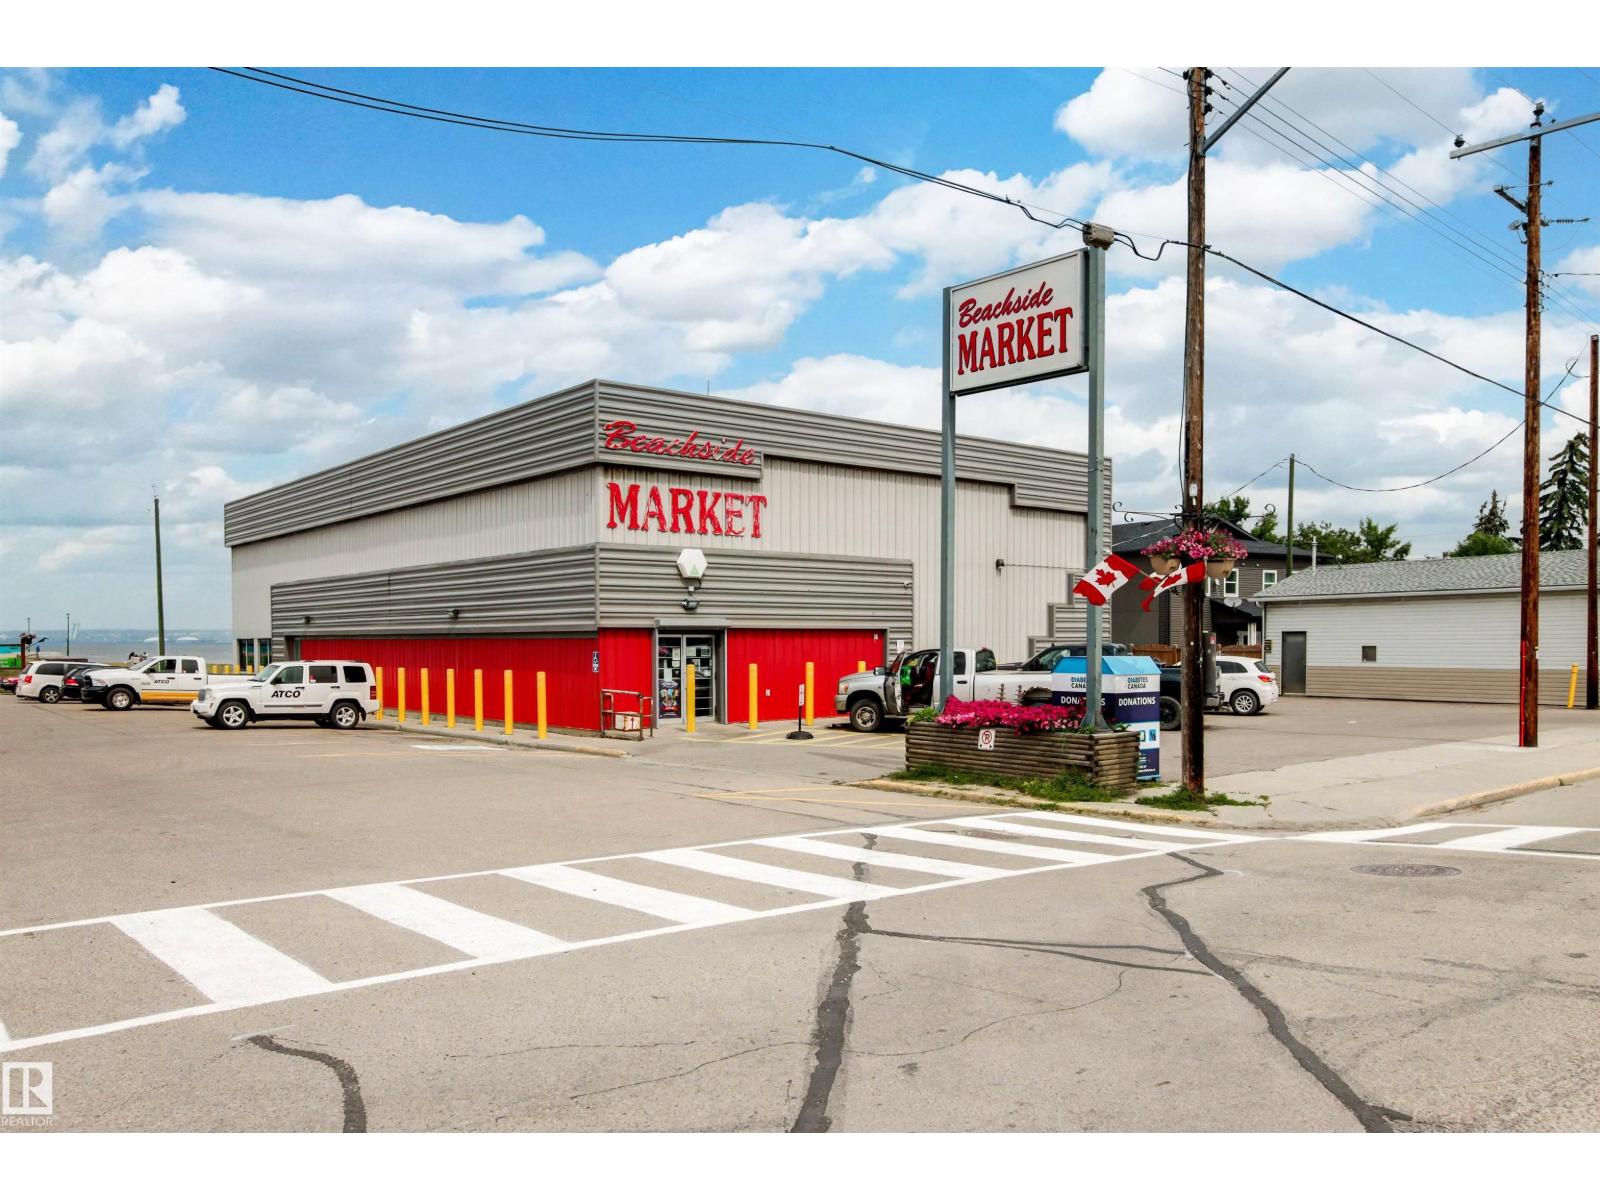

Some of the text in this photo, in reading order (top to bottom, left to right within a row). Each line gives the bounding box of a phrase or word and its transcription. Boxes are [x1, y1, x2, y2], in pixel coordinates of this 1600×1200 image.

[959, 281, 1053, 327] Beachside
[958, 307, 1073, 375] MARKET
[603, 420, 755, 464] Beachside
[607, 482, 767, 538] MARKET
[271, 690, 301, 699] ATCO
[1118, 697, 1156, 706] DONATIONS
